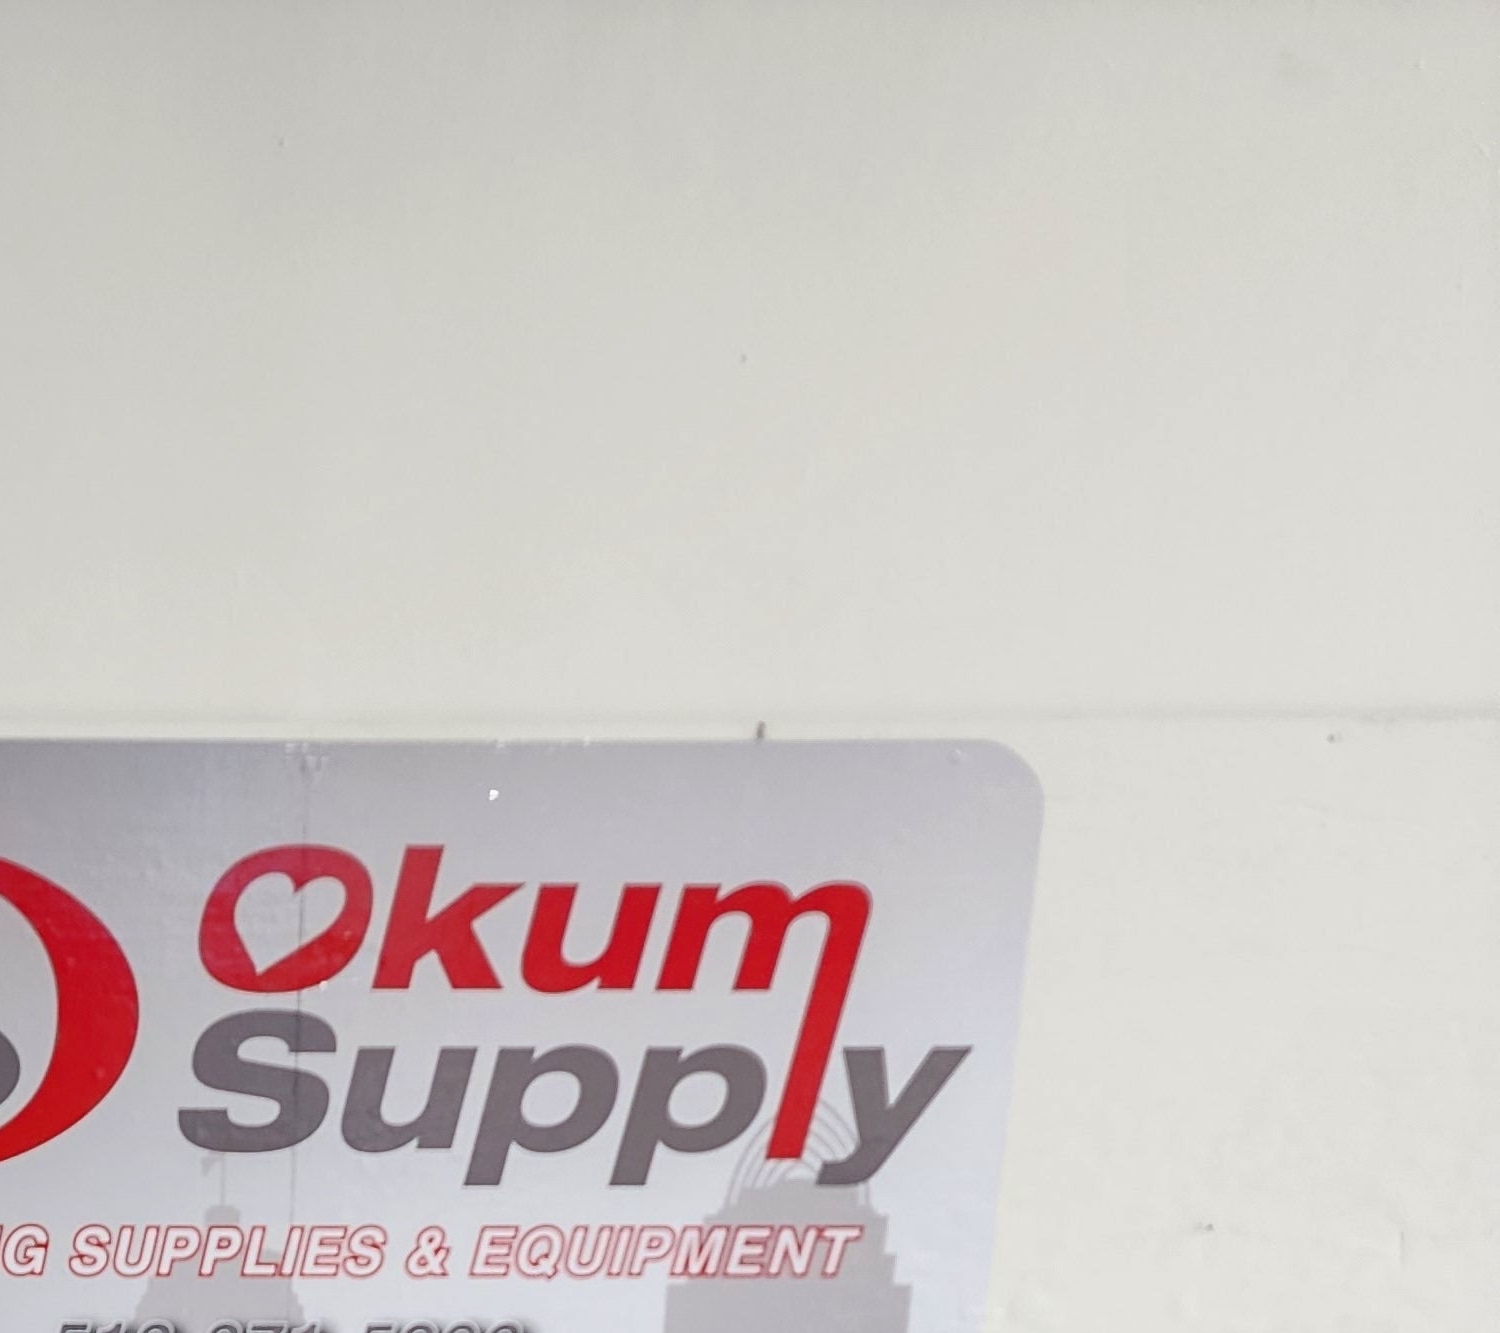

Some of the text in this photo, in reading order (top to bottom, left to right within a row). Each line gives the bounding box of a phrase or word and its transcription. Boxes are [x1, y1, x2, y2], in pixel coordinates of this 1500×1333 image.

[198, 844, 873, 1160] Okum
[178, 1007, 973, 1186] Supply
[69, 1225, 385, 1278] SUPPLIES
[406, 1225, 449, 1278] &
[469, 1225, 862, 1280] EQUIPMENT
